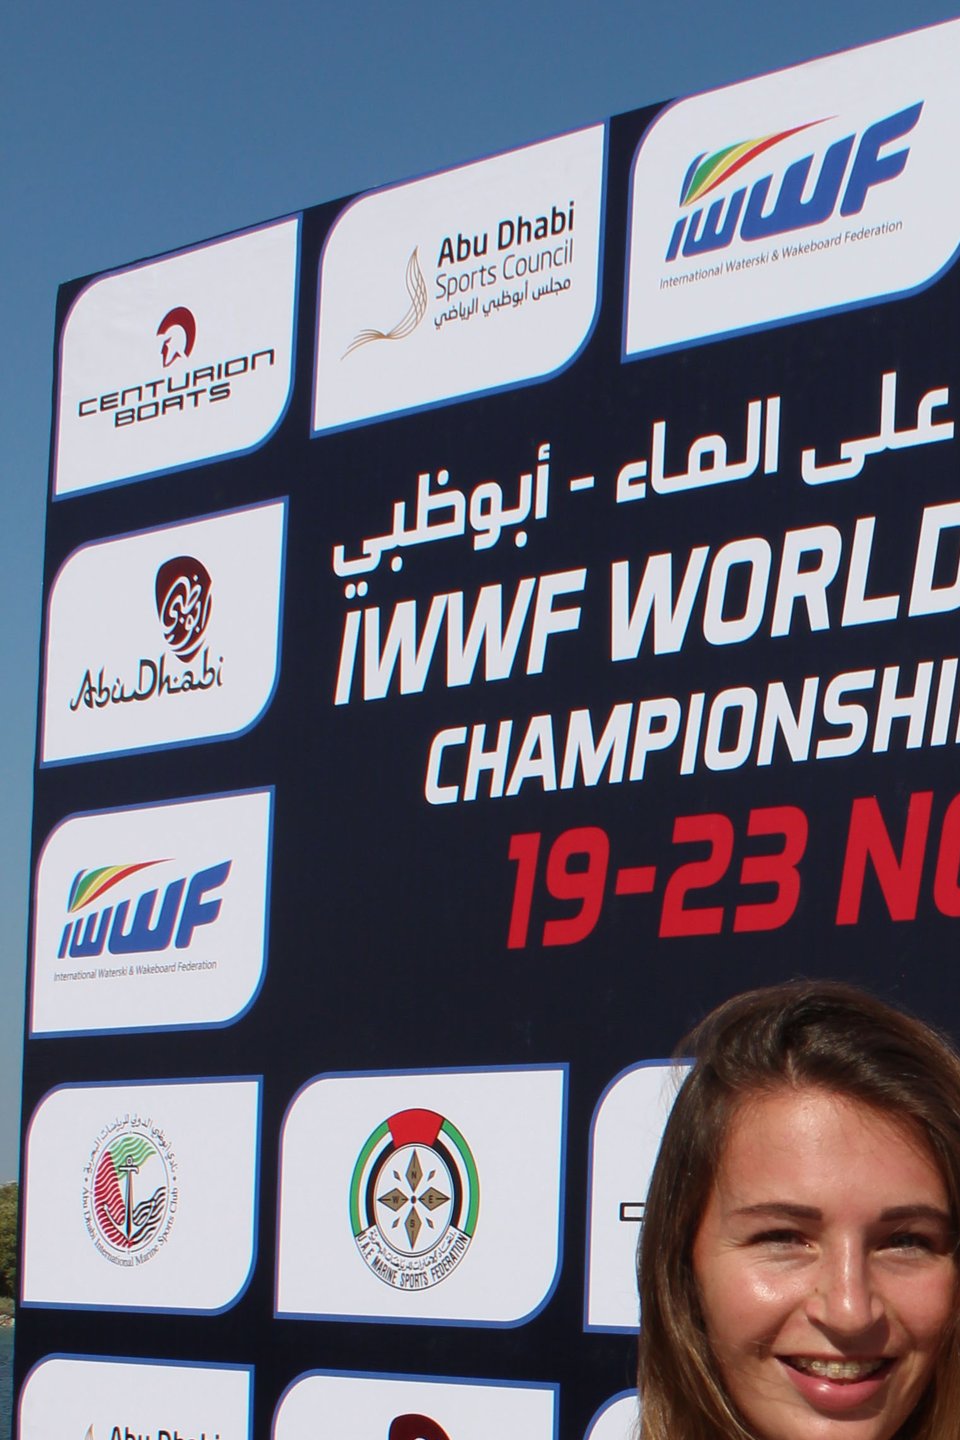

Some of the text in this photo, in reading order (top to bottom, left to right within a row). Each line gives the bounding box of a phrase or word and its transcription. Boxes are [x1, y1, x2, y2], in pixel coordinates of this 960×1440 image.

[438, 201, 574, 268] Abu Dhabi
[660, 221, 902, 289] International Waterski & Wakeboard Federation
[435, 278, 570, 329] مجلس أبوظبي الرياضي
[436, 238, 573, 301] Sports Council
[79, 349, 274, 417] CENTURION
[114, 382, 230, 427] BOATS
[616, 396, 780, 503] الماء
[801, 371, 954, 486] على
[333, 443, 550, 577] أبوظبي
[334, 568, 587, 705] IWWF
[508, 806, 808, 948] 19-23
[54, 970, 97, 981] International
[178, 961, 216, 971] Federation
[371, 1256, 398, 1284] MARINE
[400, 1271, 428, 1288] SPORTS
[431, 1234, 468, 1281] FEDERATION
